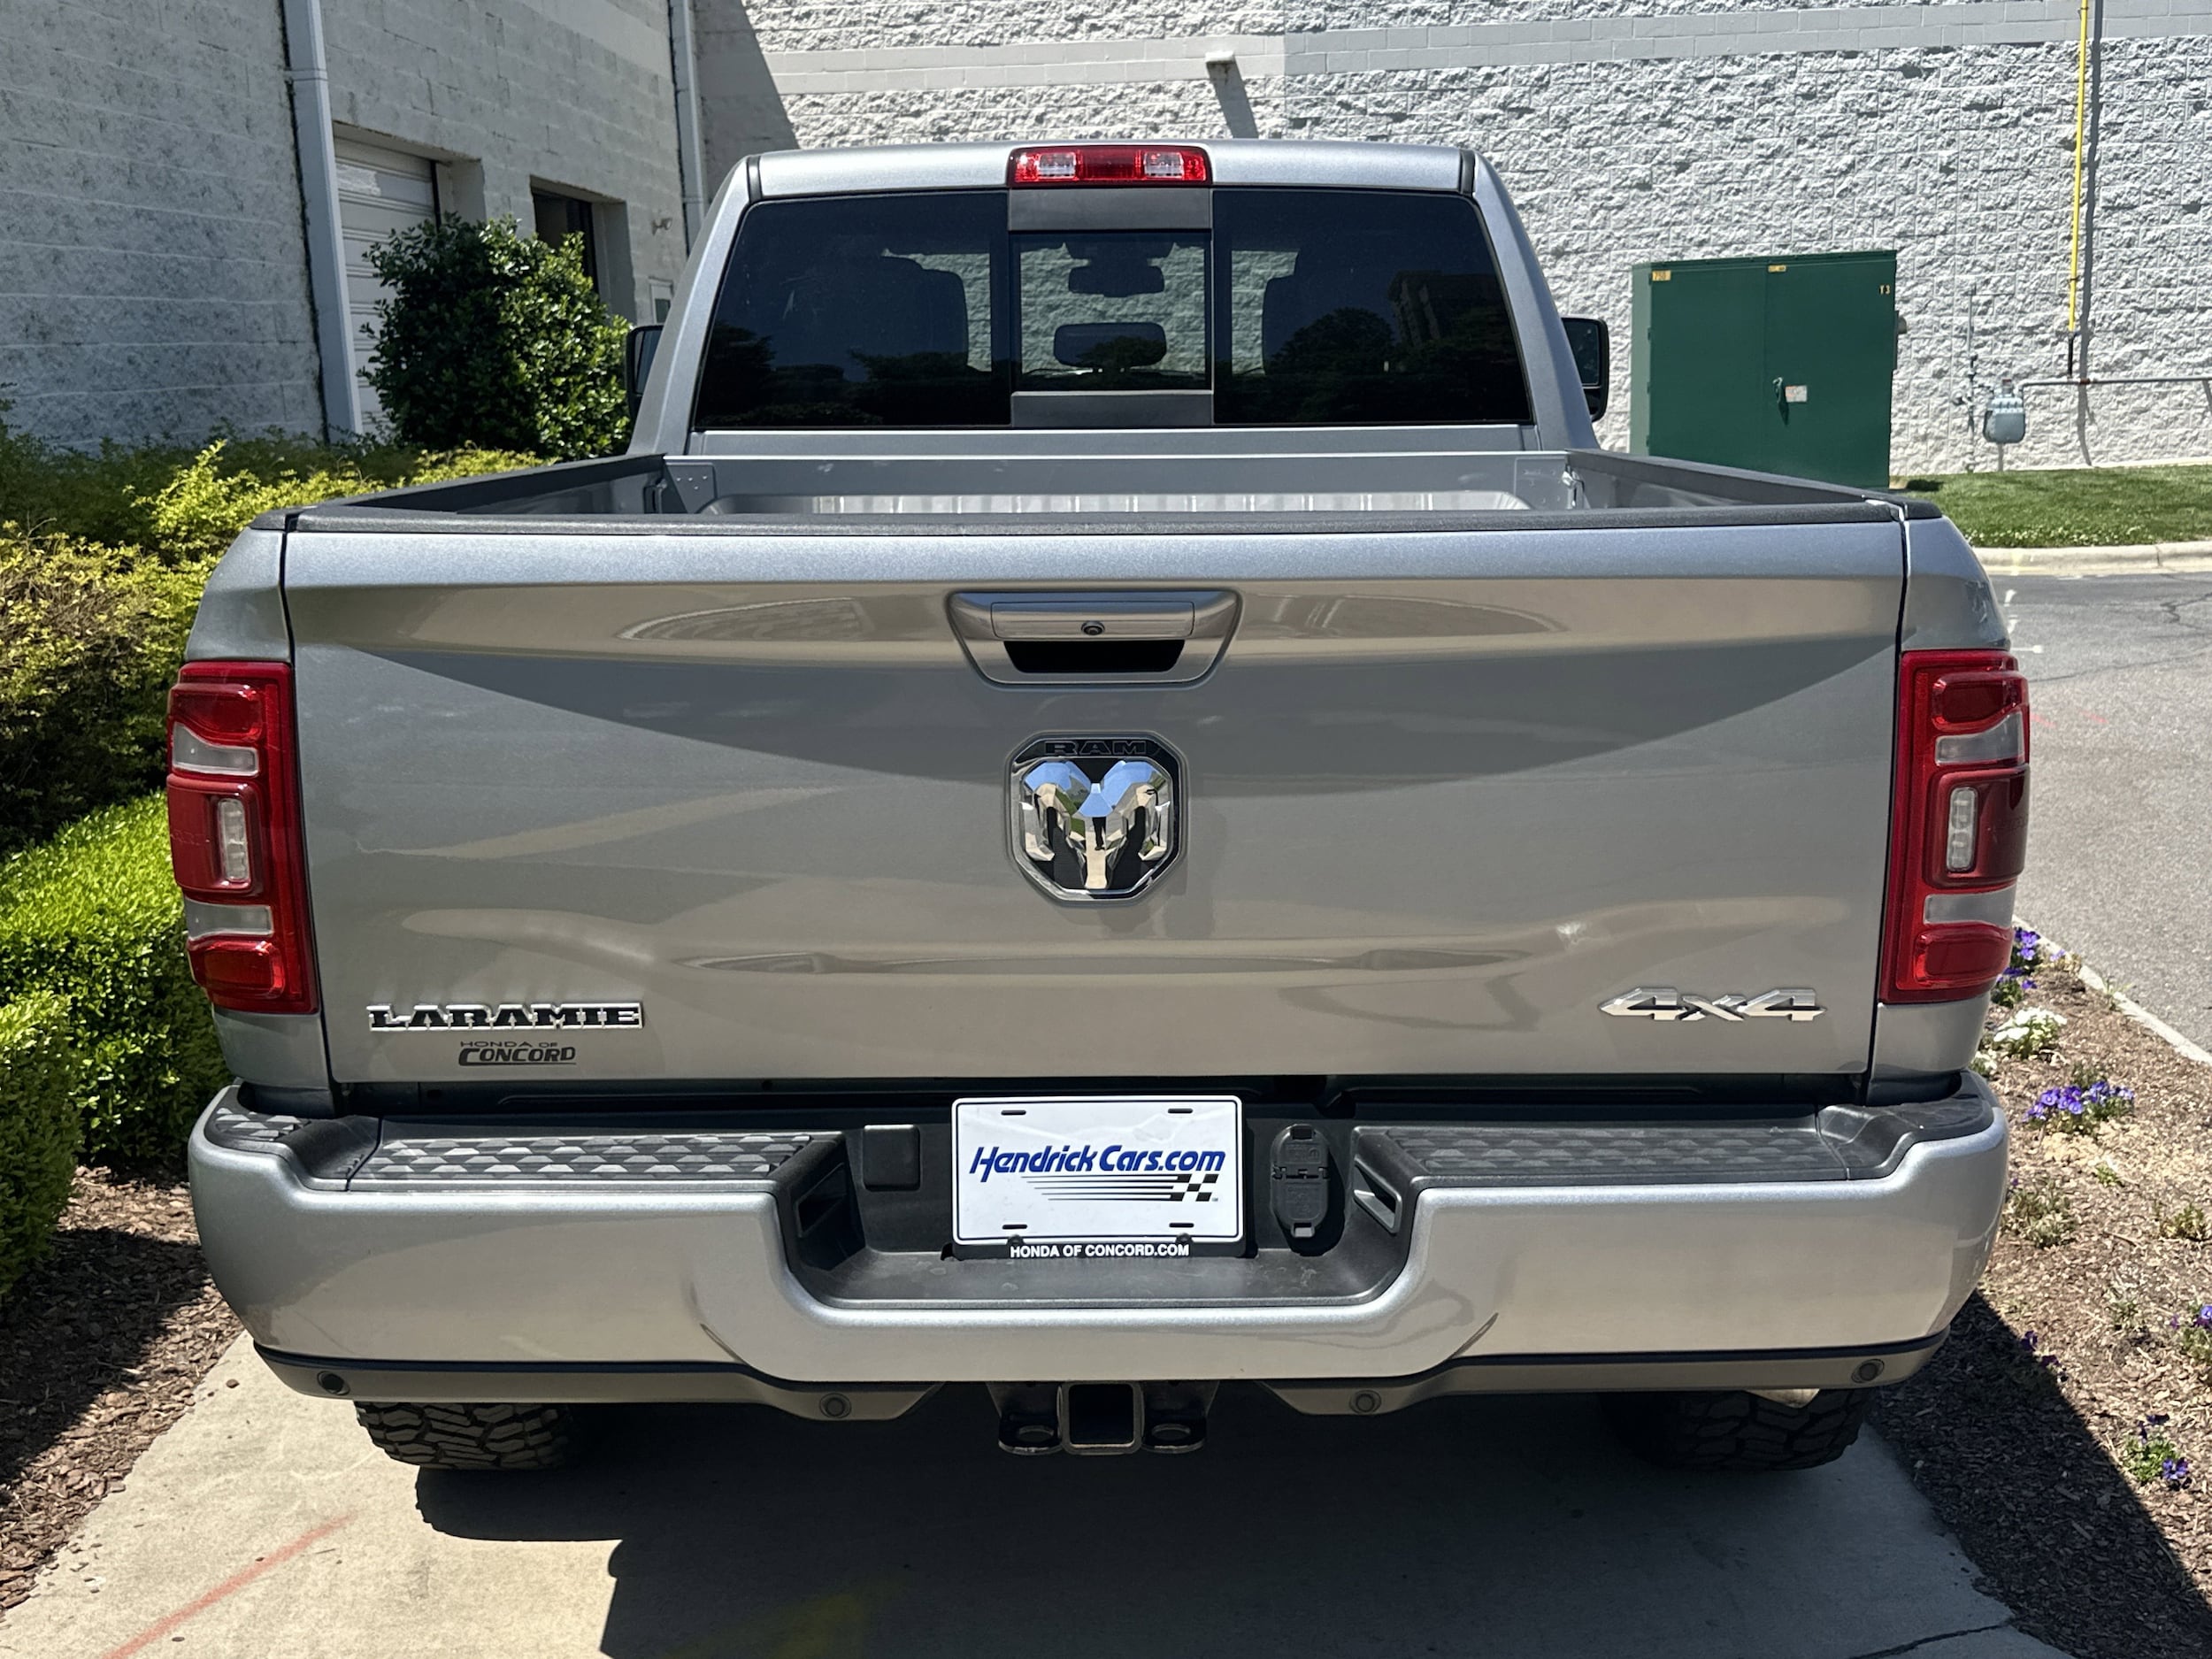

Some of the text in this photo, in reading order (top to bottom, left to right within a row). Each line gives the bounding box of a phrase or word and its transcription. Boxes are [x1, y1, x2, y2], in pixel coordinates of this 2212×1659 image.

[1045, 741, 1147, 755] RAM
[366, 1002, 643, 1032] LARAMIE
[458, 1047, 576, 1066] CONCORD
[1010, 1243, 1189, 1258] HONDA OF CONCORD.COM
